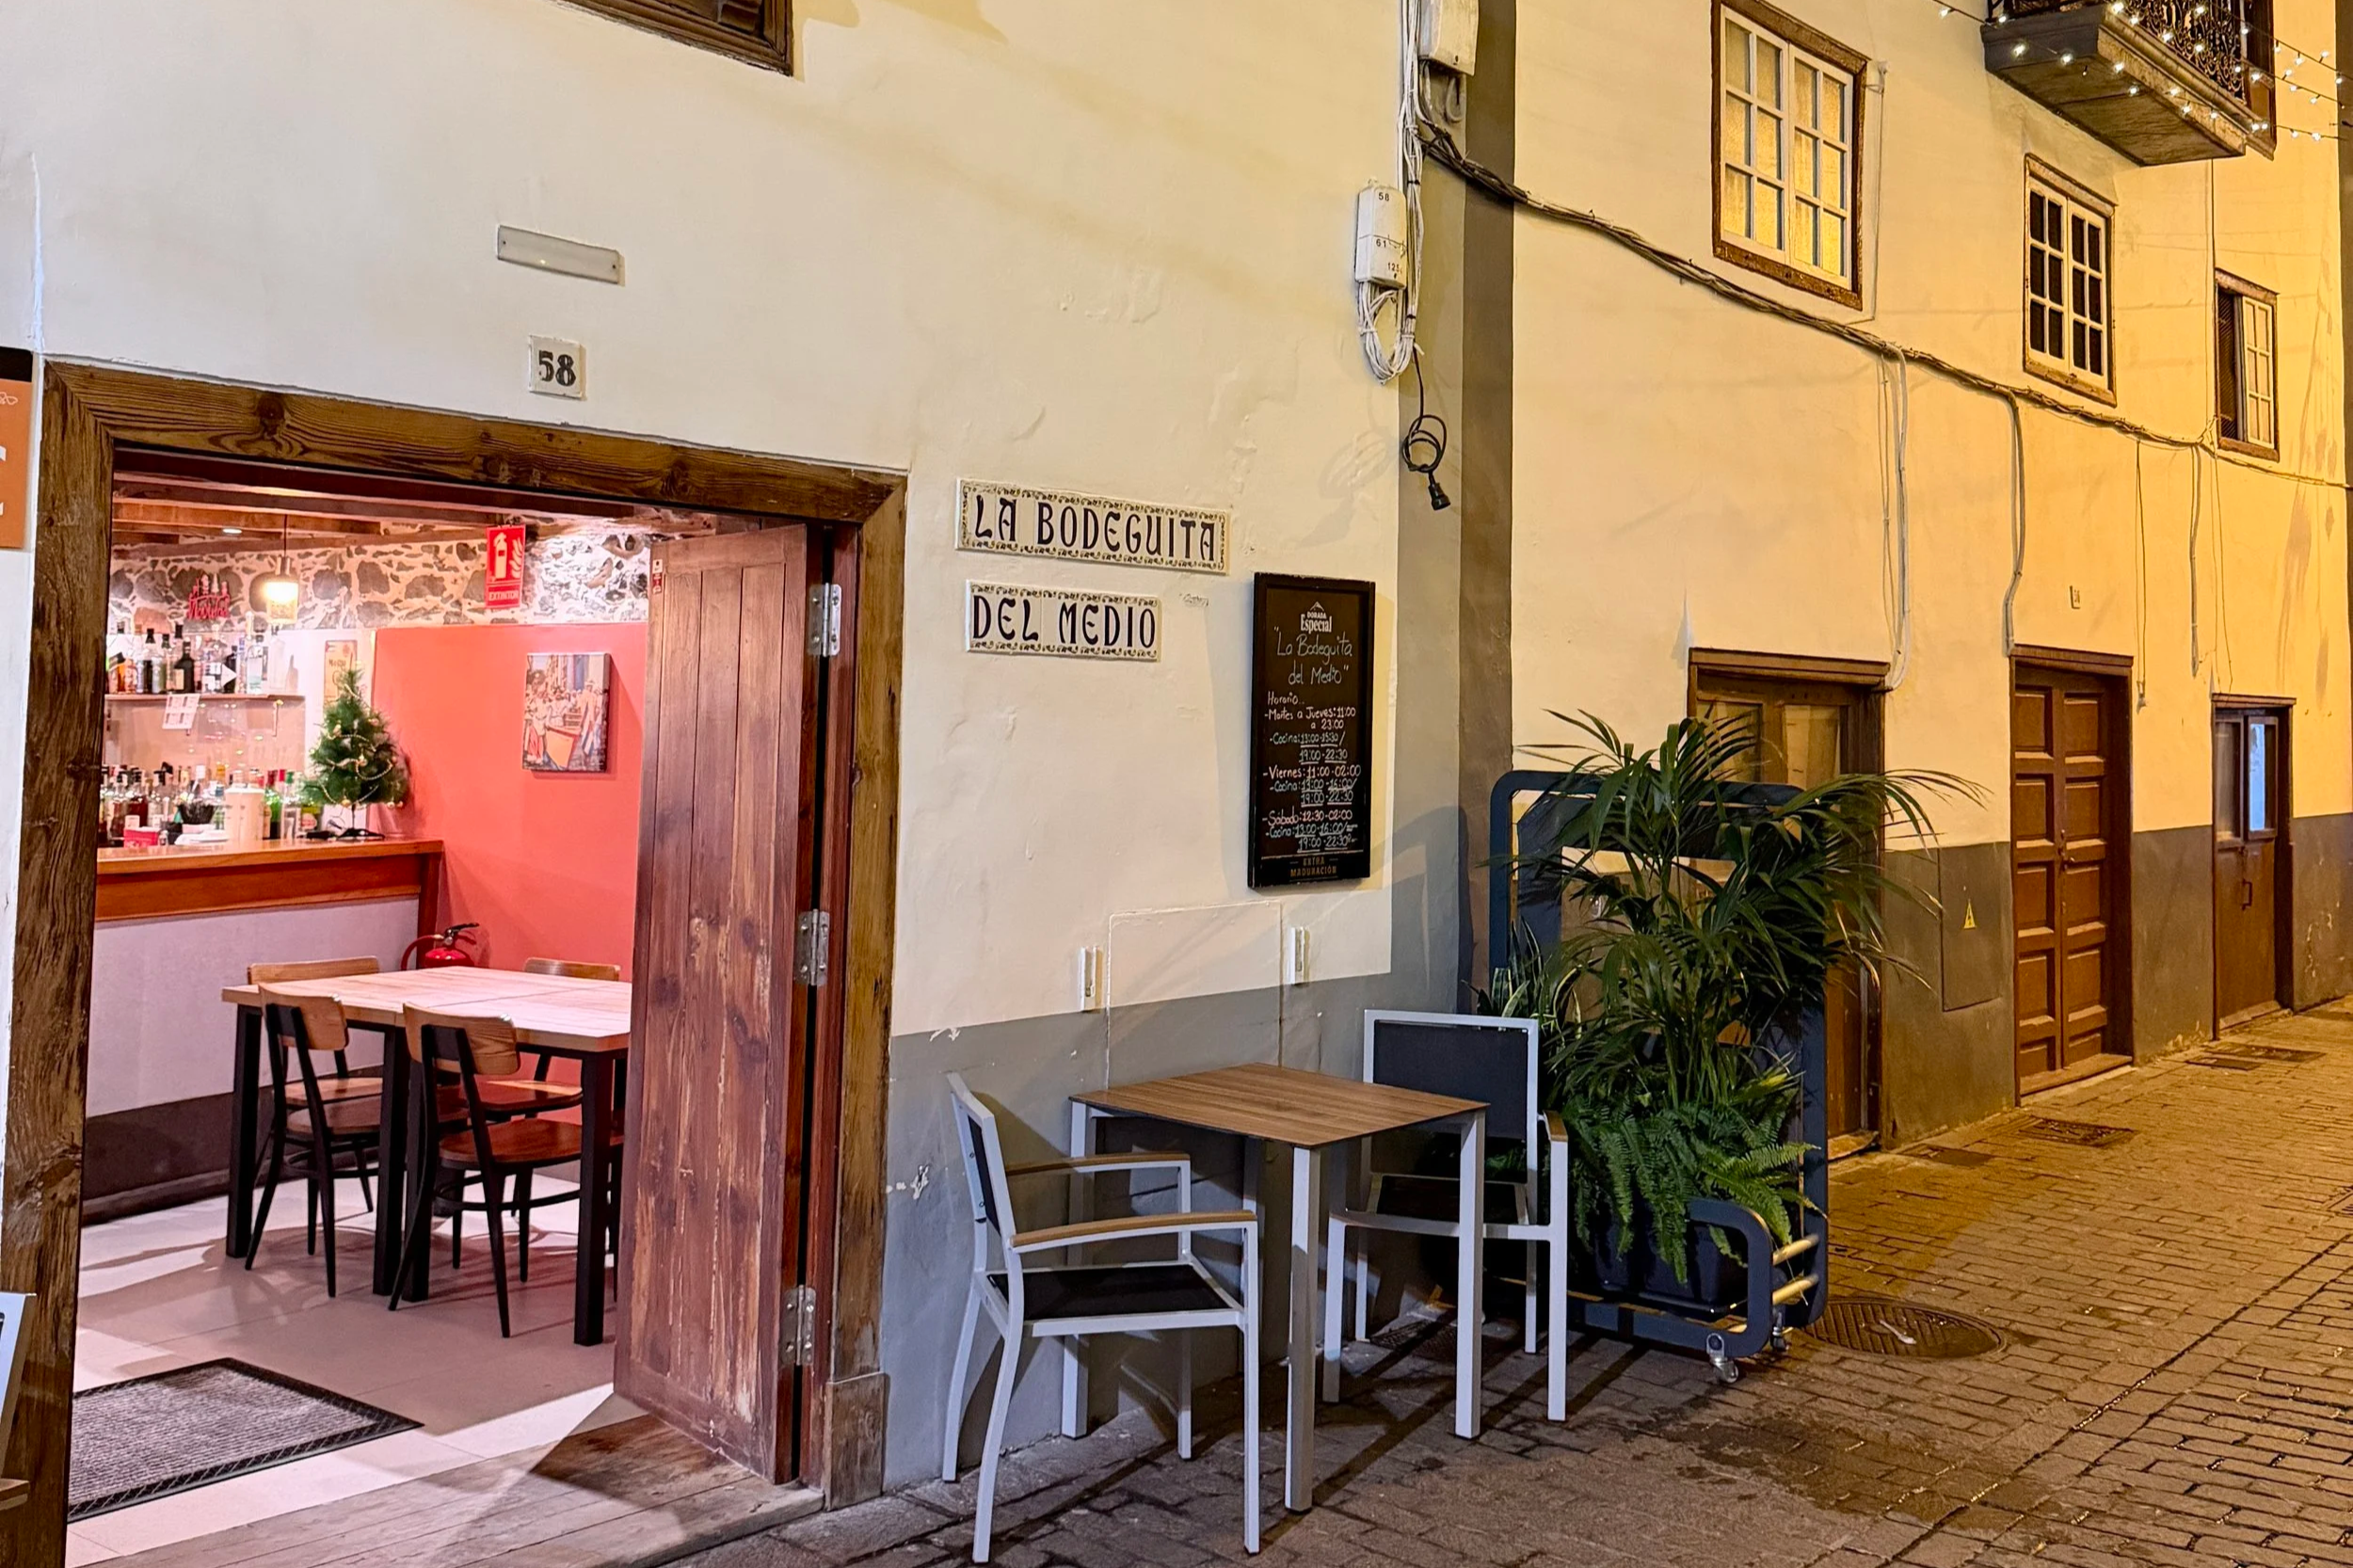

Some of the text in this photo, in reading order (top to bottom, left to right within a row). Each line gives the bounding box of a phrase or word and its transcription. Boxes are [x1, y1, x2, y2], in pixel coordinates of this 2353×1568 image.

[1379, 192, 1389, 201] 58
[538, 350, 576, 387] 58
[974, 494, 1214, 562] LA BODEGUITA
[972, 595, 1156, 648] DEL MEDIO
[1300, 614, 1333, 634] Especial
[1289, 660, 1304, 685] del
[1297, 710, 1304, 719] a
[1310, 718, 1344, 730] a 23:00
